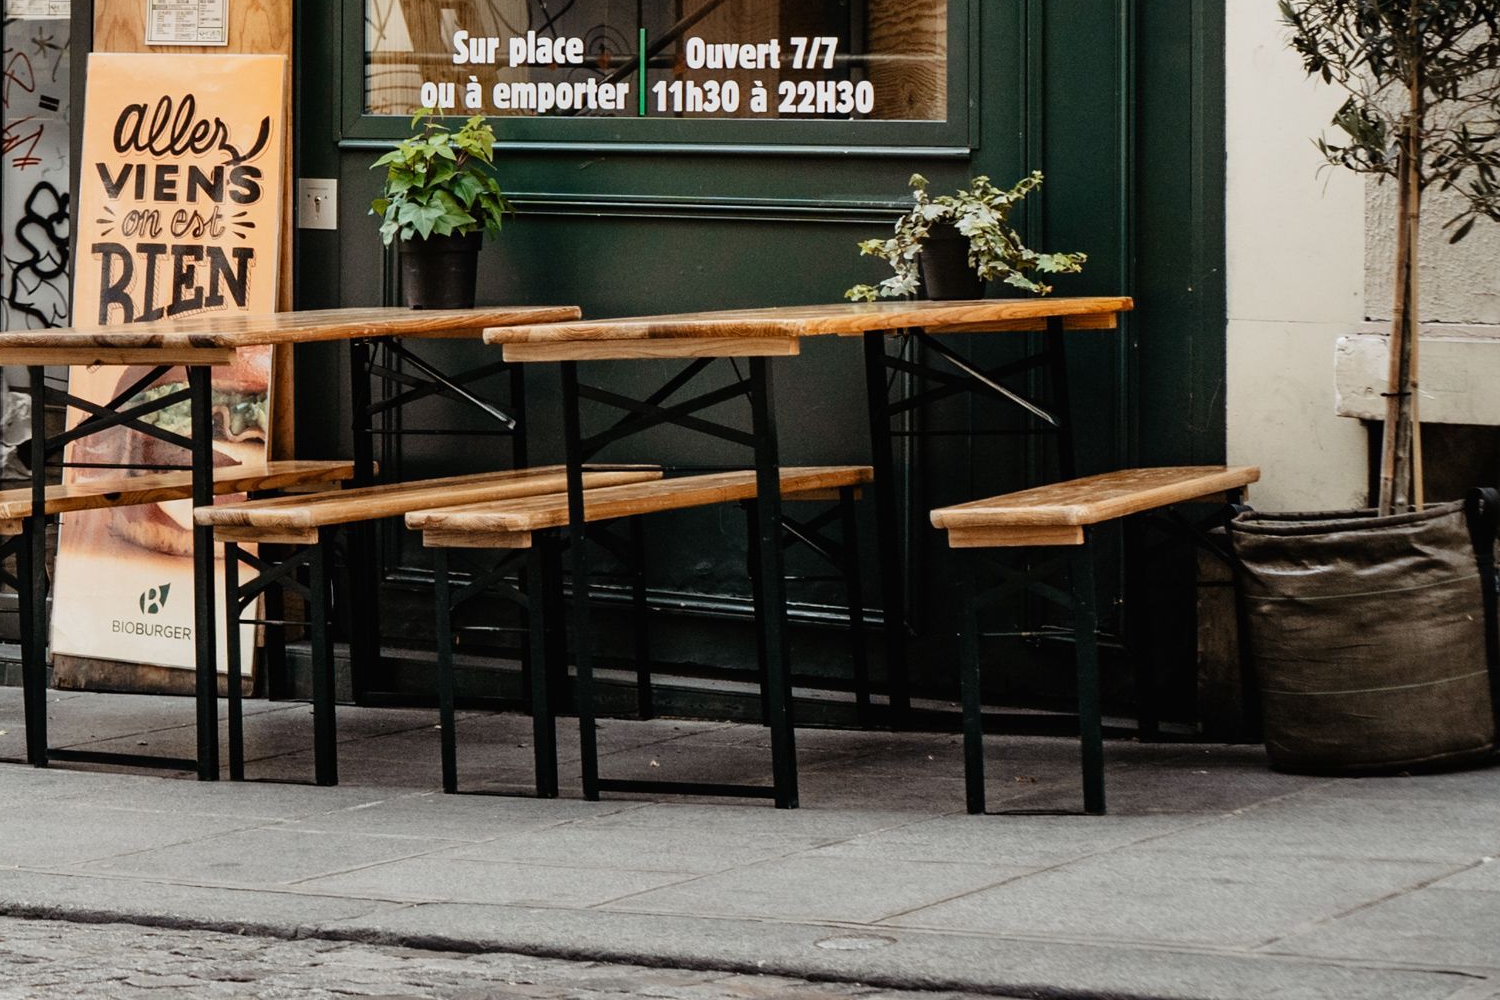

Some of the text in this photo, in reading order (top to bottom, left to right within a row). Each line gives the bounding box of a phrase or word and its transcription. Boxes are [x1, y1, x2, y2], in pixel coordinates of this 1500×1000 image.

[452, 30, 584, 68] Sur place
[686, 37, 839, 70] Ouvert 7/7
[420, 75, 629, 113] ou à emporter
[652, 80, 875, 114] 11h30 à 22H30
[95, 162, 263, 204] VIENS
[122, 206, 226, 238] on est
[112, 620, 192, 640] BIOBURGER
